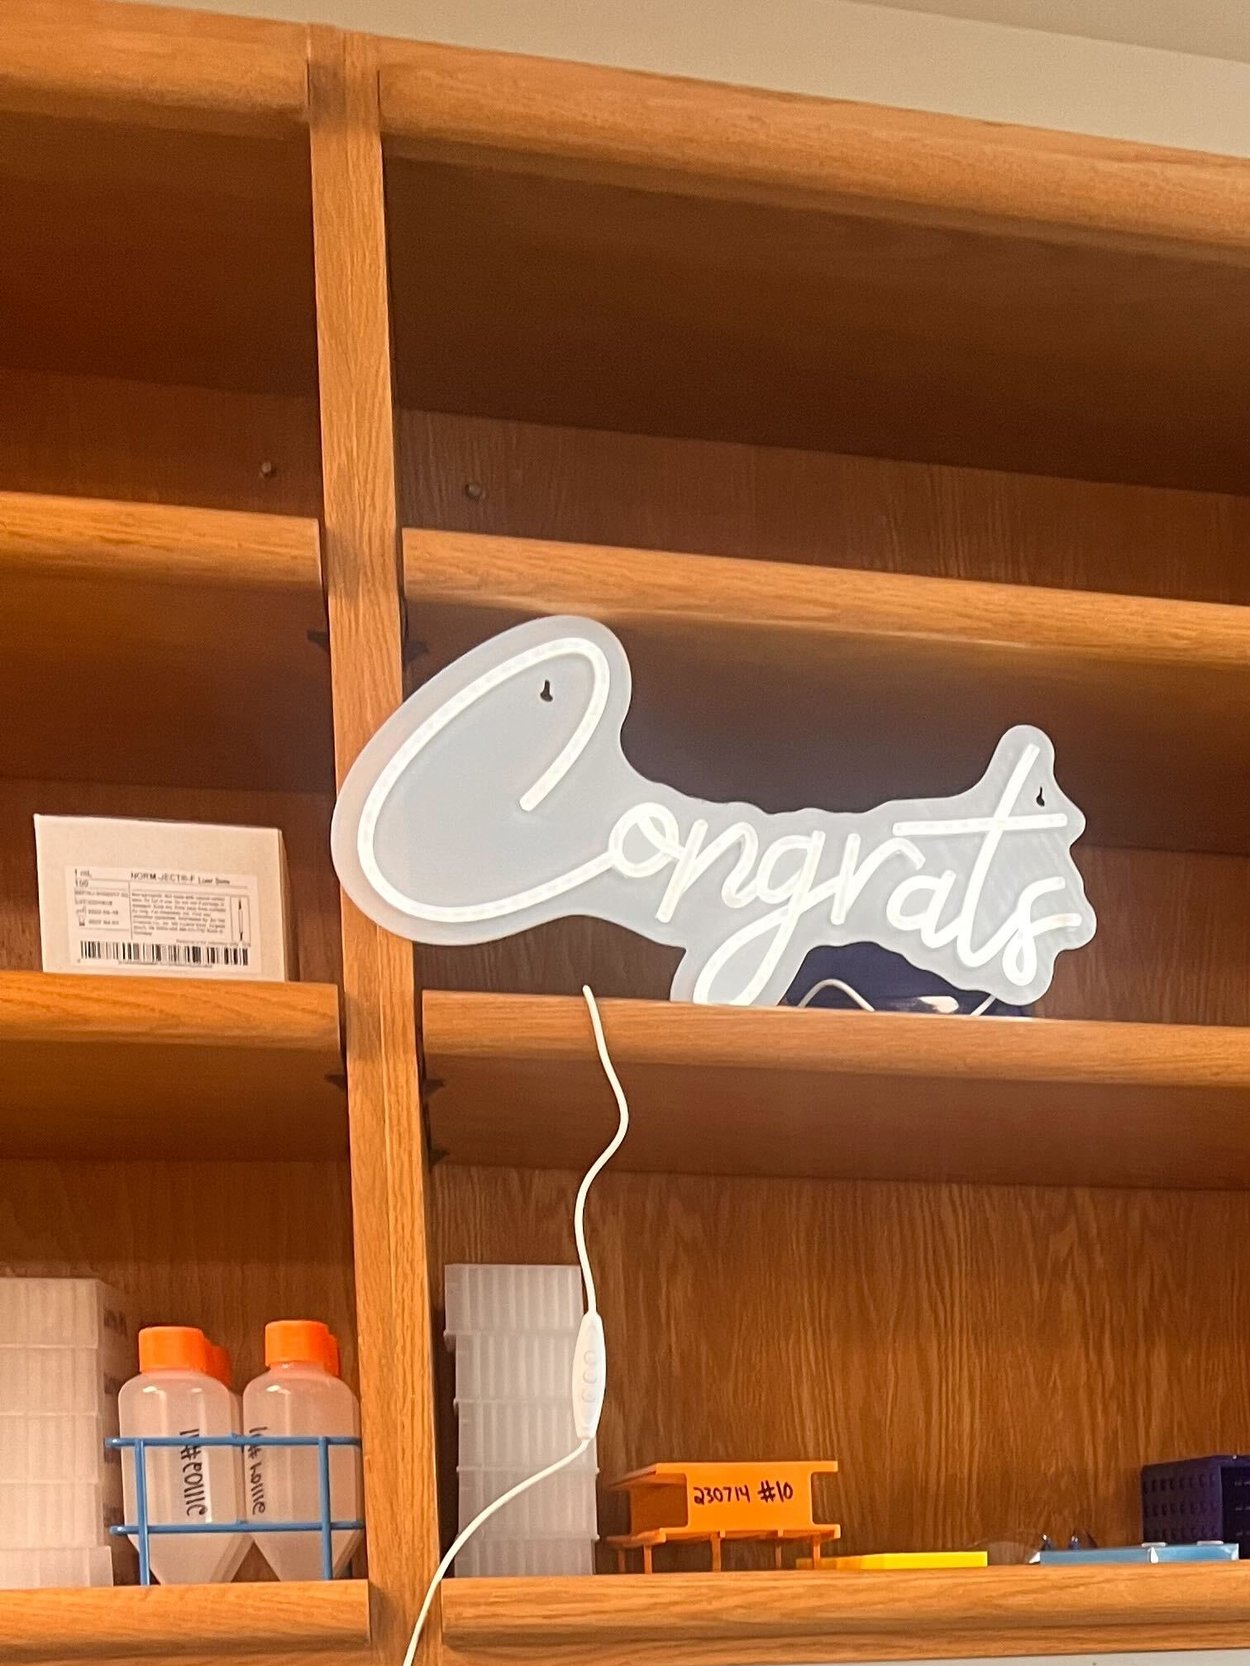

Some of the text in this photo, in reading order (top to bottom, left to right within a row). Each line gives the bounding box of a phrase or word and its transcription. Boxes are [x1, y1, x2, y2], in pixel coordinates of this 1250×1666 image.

[357, 636, 1083, 1005] Congrats
[693, 1480, 794, 1505] 230714 #10
